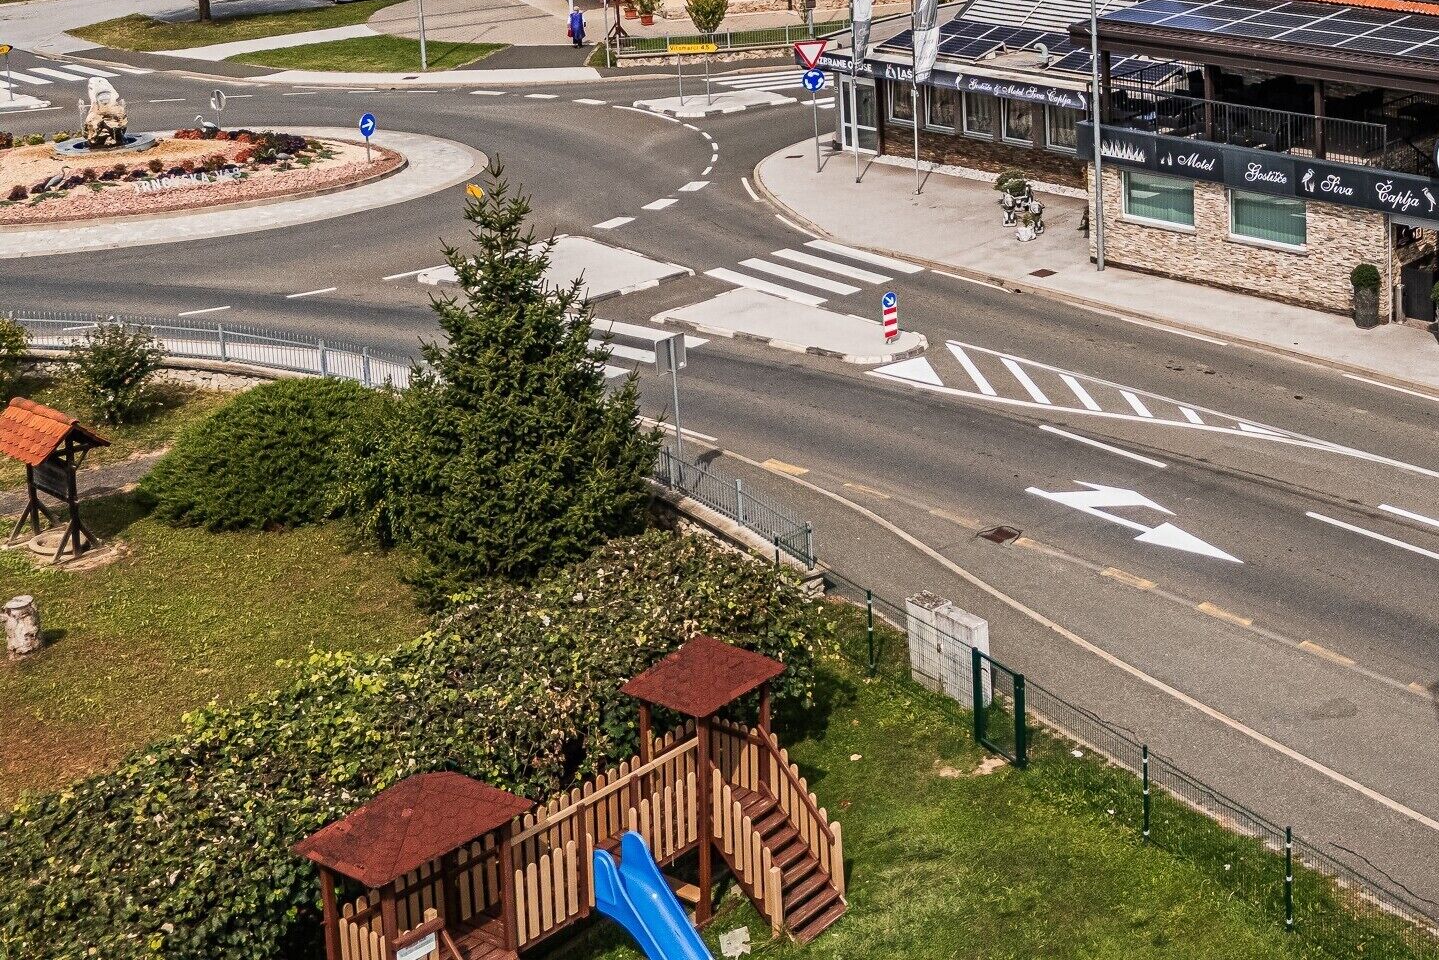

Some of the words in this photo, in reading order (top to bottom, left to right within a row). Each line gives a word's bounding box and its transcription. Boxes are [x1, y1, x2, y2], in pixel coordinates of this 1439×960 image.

[1002, 85, 1024, 96] Motel
[1025, 86, 1045, 100] Siva
[1046, 88, 1072, 107] Čaplja
[1177, 152, 1216, 171] Motel
[1244, 162, 1287, 185] Gostišče
[1320, 174, 1354, 196] Siva
[1375, 180, 1420, 211] Čaplja
